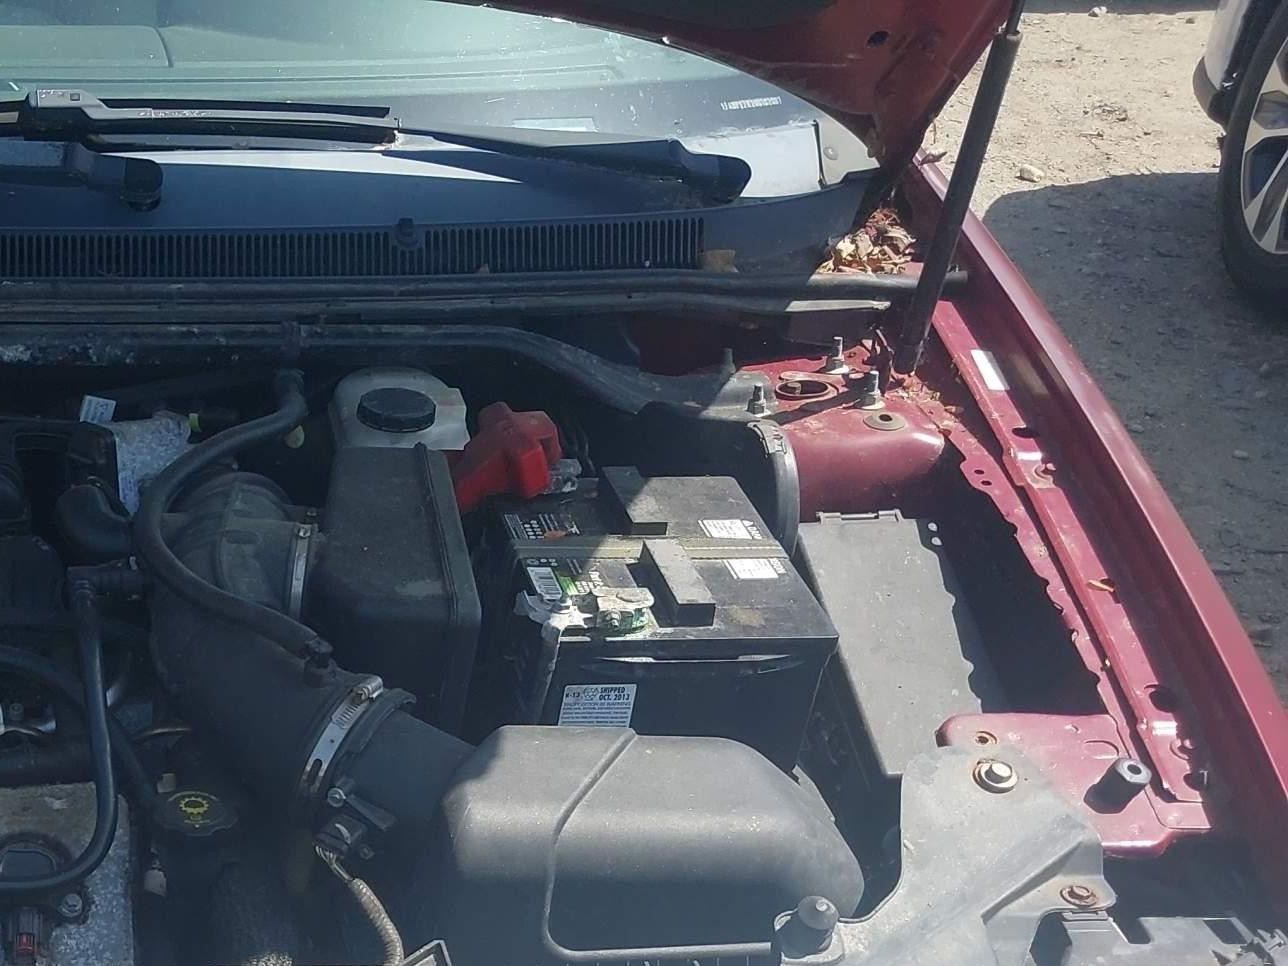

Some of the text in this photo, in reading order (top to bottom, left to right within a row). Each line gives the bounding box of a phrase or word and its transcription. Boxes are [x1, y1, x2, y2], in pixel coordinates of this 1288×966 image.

[599, 686, 626, 694] SHIPPED
[598, 693, 631, 701] OCT. 2013
